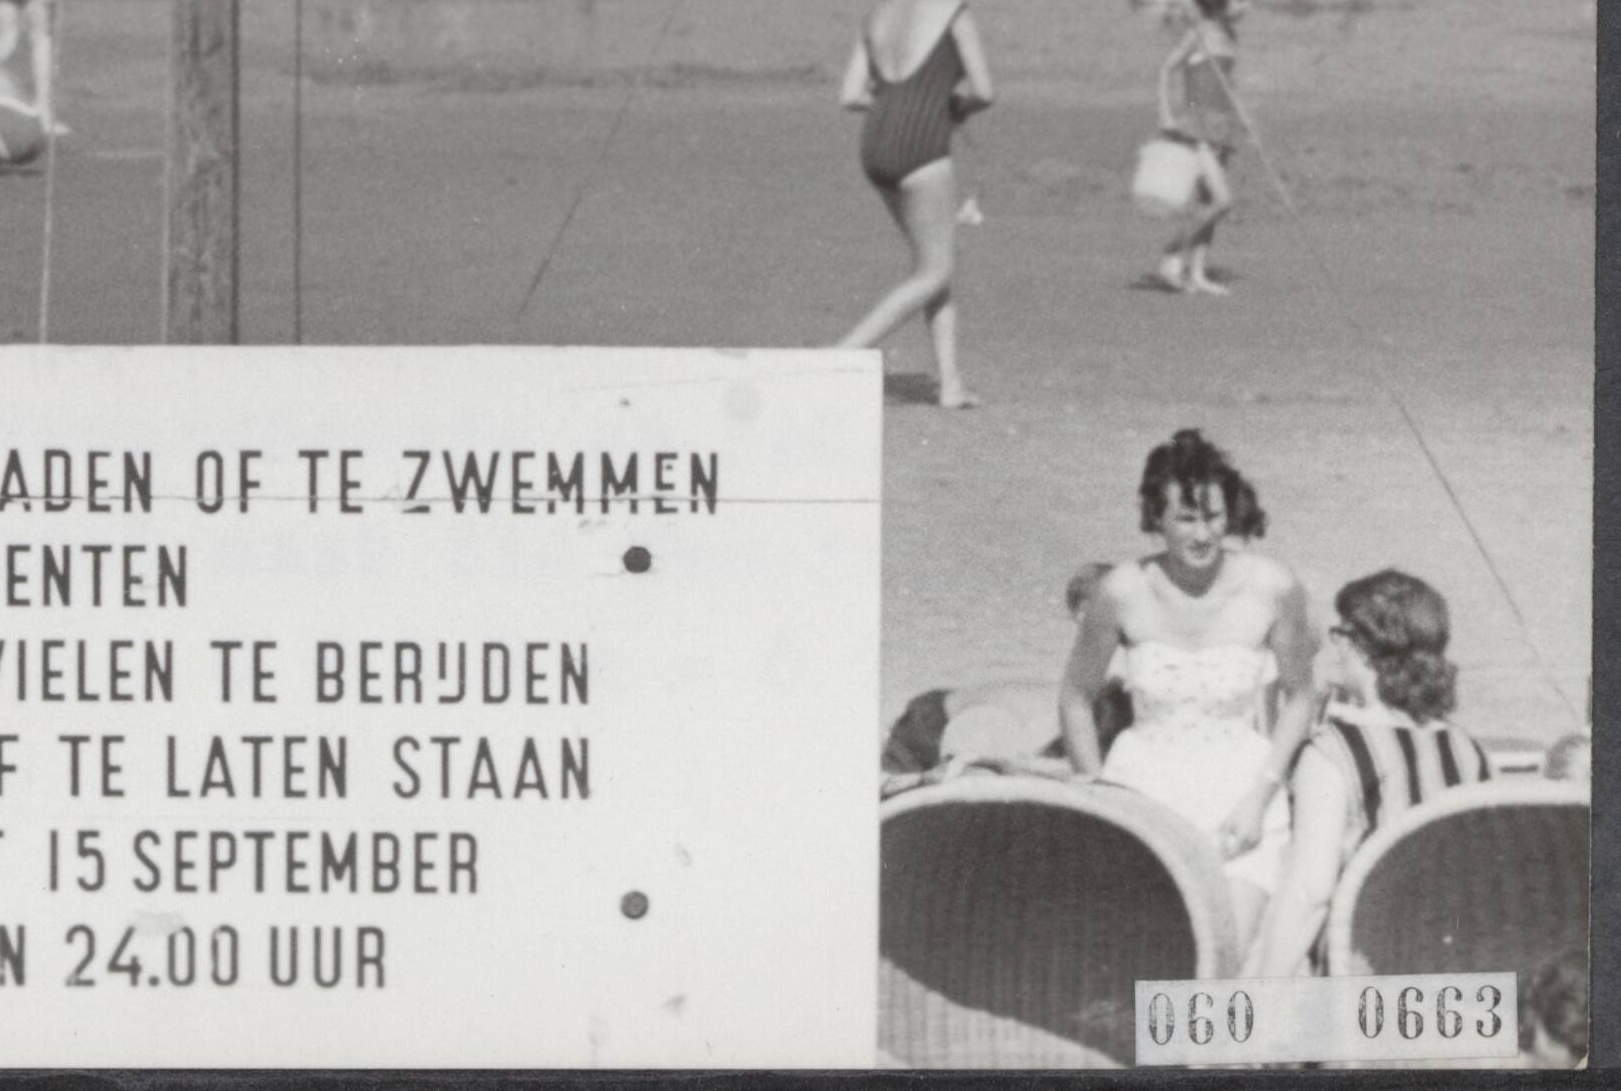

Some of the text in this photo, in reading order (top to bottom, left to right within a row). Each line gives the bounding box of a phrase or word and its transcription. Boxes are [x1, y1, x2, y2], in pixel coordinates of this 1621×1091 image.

[196, 450, 262, 514] OF
[298, 449, 363, 514] TE
[401, 450, 718, 514] ZWEMMEN
[211, 640, 277, 703] TE
[316, 641, 588, 704] BERIJDEN
[59, 735, 124, 797] TE
[167, 736, 347, 798] LATEN
[393, 736, 589, 799] STAAN
[50, 830, 105, 892] 15
[133, 830, 477, 894] SEPTEMBER
[66, 924, 238, 987] 24.00
[270, 926, 385, 988] UUR
